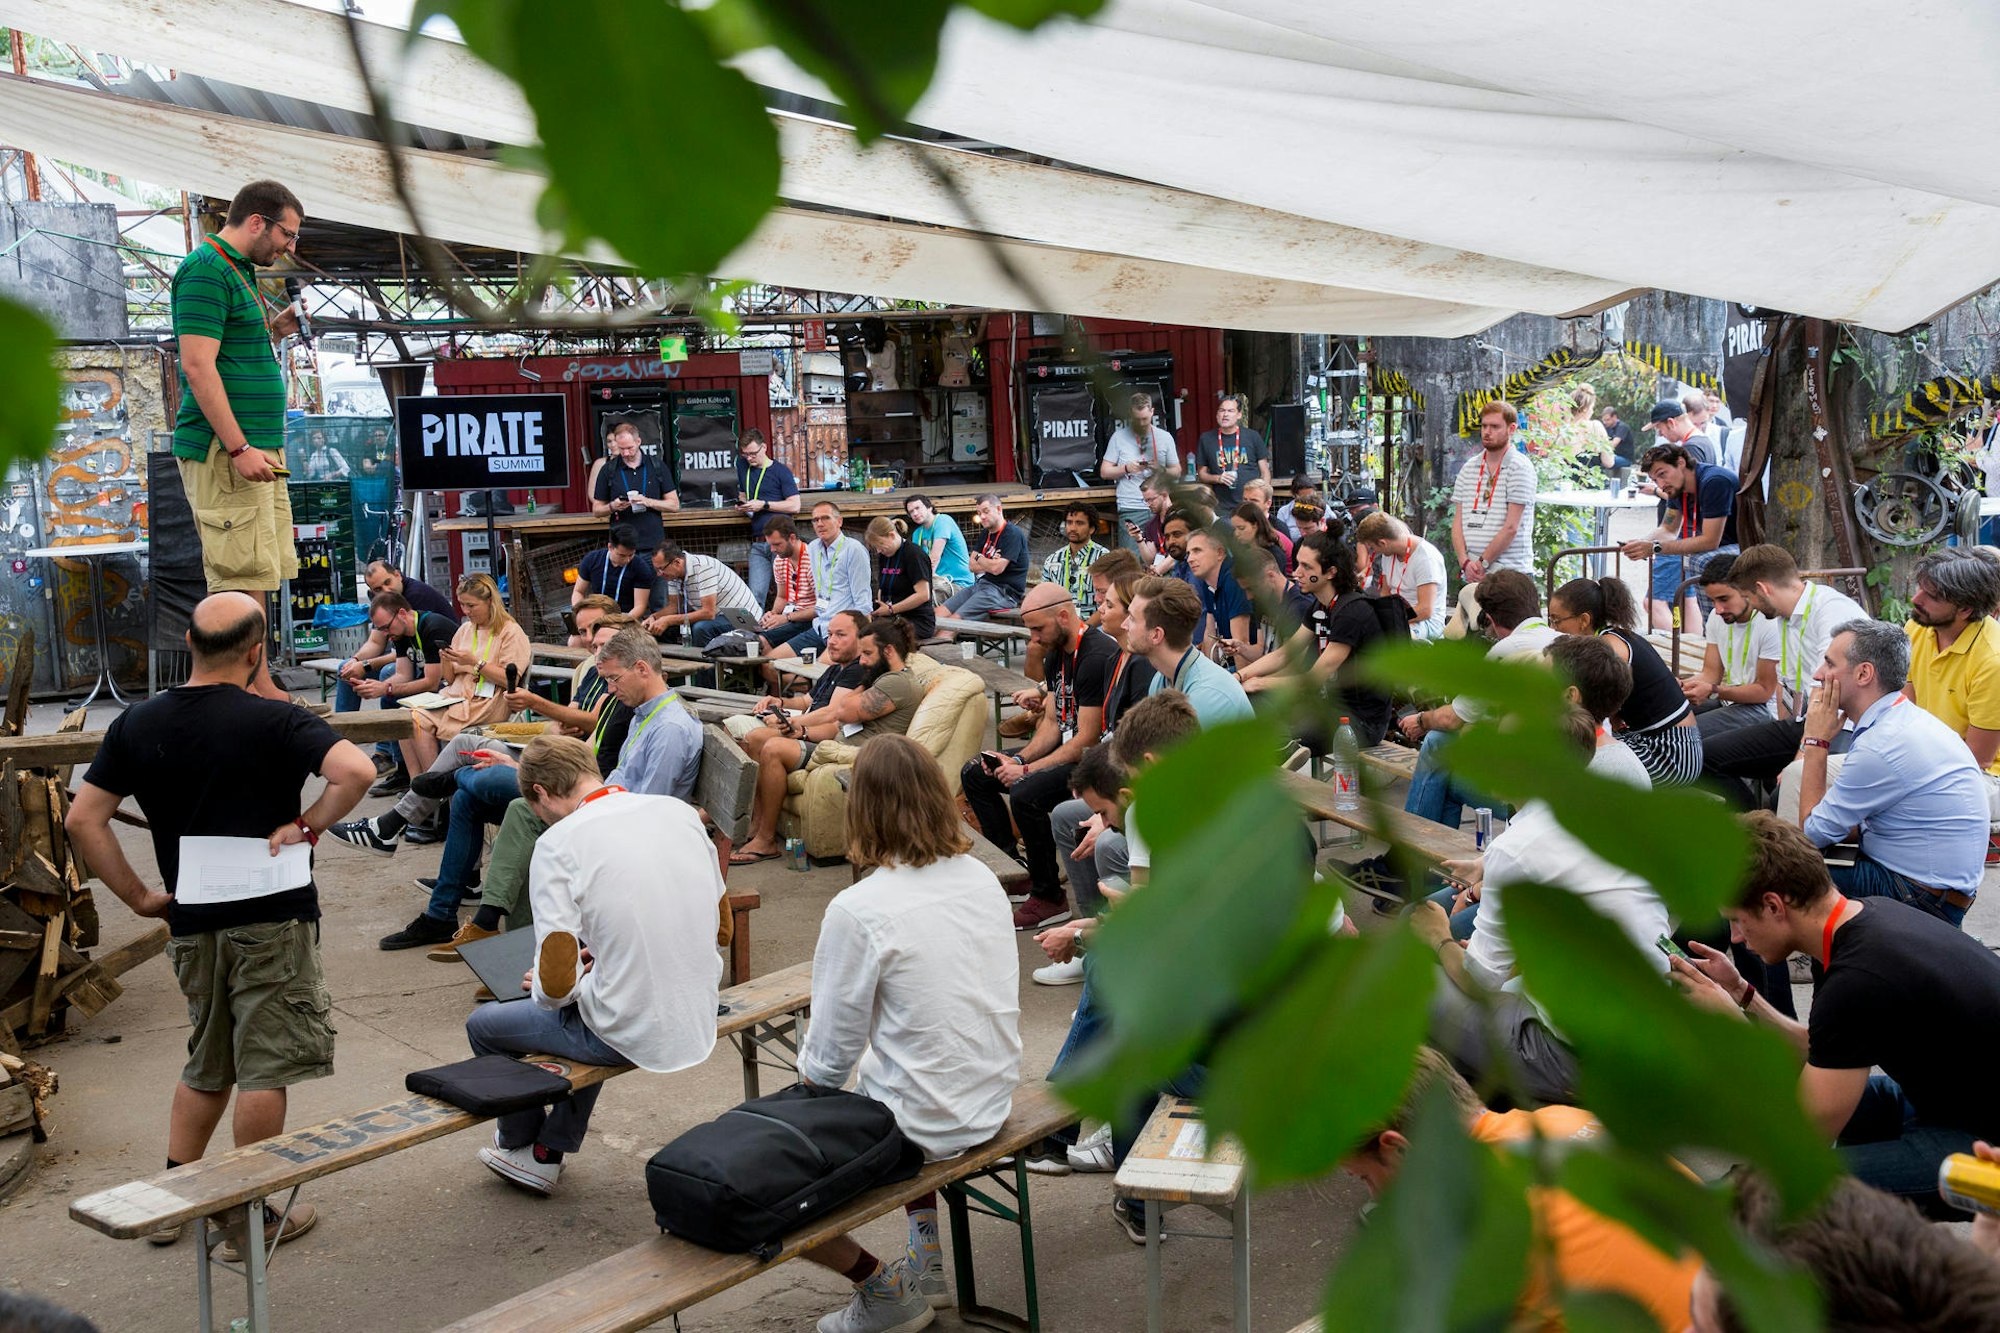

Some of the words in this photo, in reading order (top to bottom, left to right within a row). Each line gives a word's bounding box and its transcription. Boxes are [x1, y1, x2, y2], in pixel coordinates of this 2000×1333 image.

[1728, 318, 1768, 358] PIRAT
[421, 411, 544, 457] PIRATE
[1043, 419, 1089, 439] PIRATE
[493, 459, 541, 470] SUMMIT
[684, 450, 732, 470] PIRATE
